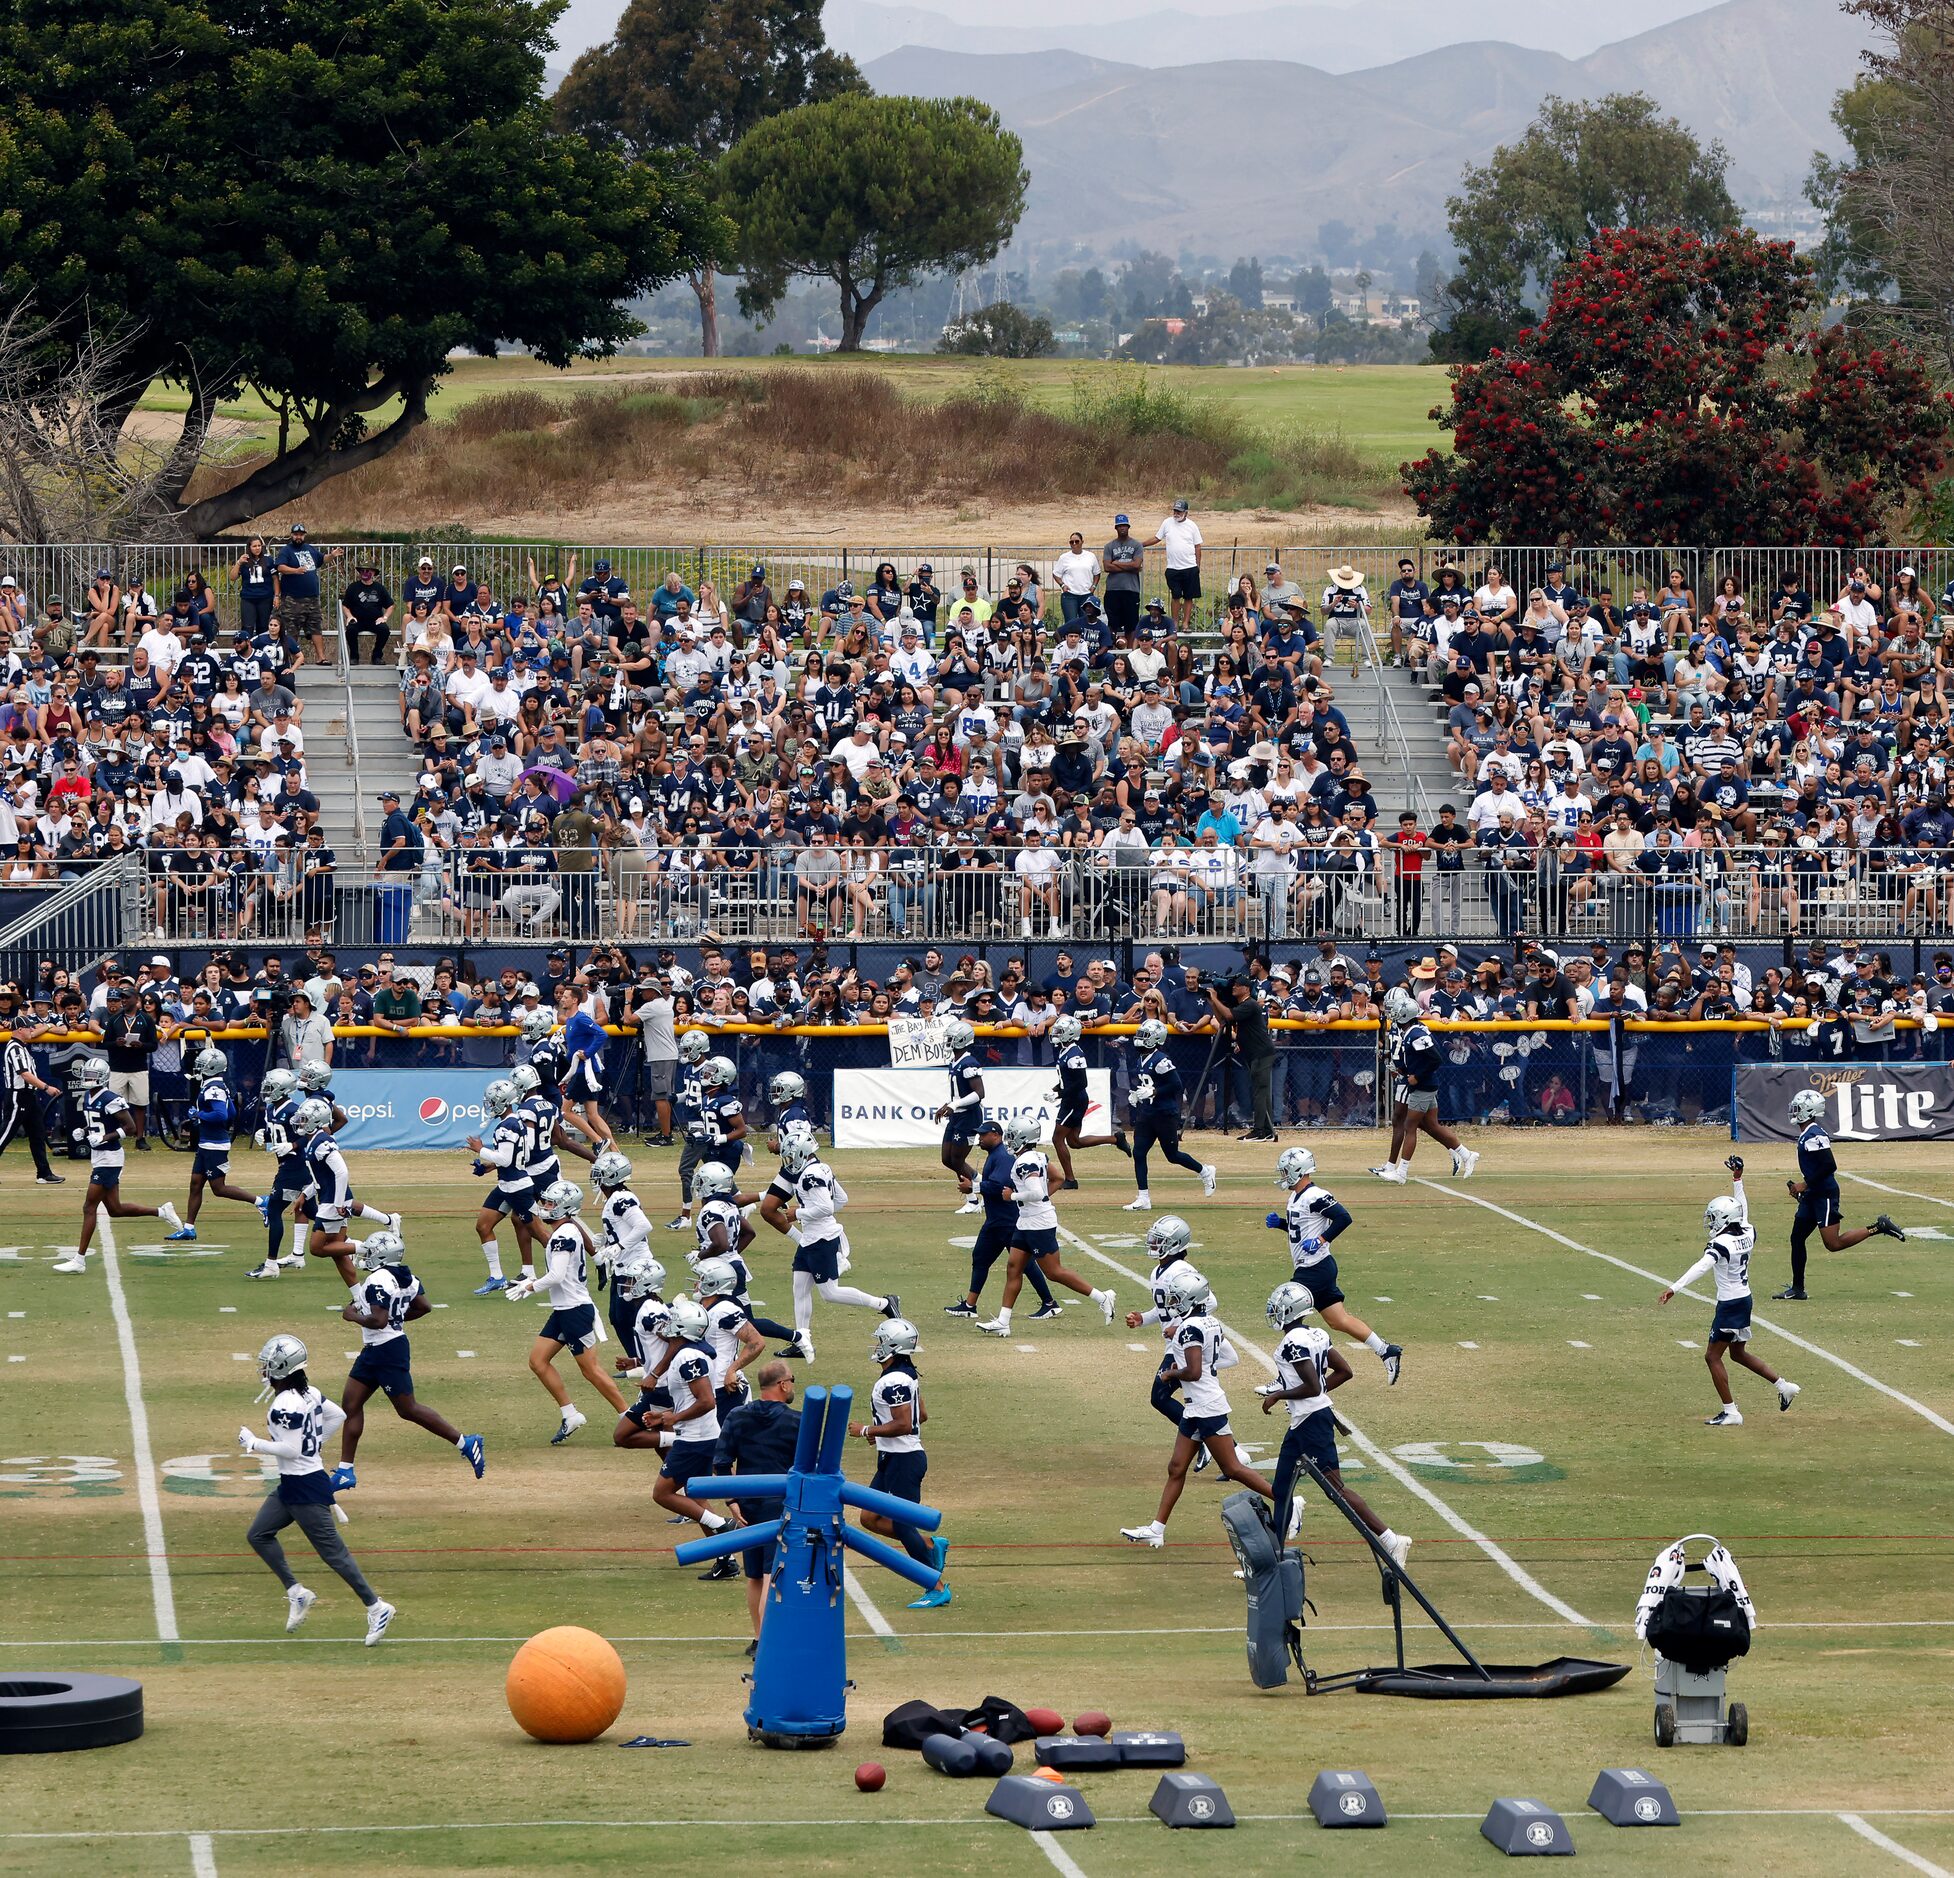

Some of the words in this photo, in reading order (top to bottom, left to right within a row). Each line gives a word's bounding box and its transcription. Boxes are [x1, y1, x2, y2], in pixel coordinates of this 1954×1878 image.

[1635, 640, 1651, 653] 21
[716, 656, 724, 670] 4
[1570, 651, 1581, 667] 4
[908, 662, 921, 679] 4
[1745, 673, 1765, 690] 88
[734, 685, 743, 697] 8
[826, 702, 839, 720] 11
[667, 791, 691, 812] 94
[712, 794, 724, 811] 4
[968, 795, 991, 815] 88
[47, 831, 61, 848] 11
[520, 856, 547, 864] COWBOYS
[906, 1020, 923, 1033] BAY
[1829, 1031, 1844, 1056] 7
[893, 1043, 922, 1064] DEM
[1809, 1068, 1868, 1097] Miller
[841, 1105, 903, 1120] BANK
[910, 1105, 937, 1120] OF
[984, 1105, 1050, 1121] ERICA
[1831, 1082, 1934, 1141] Lite
[1053, 1801, 1065, 1814] R
[1195, 1801, 1208, 1814] R
[1347, 1797, 1359, 1810] R
[1642, 1802, 1654, 1814] R
[1534, 1827, 1546, 1840] R
